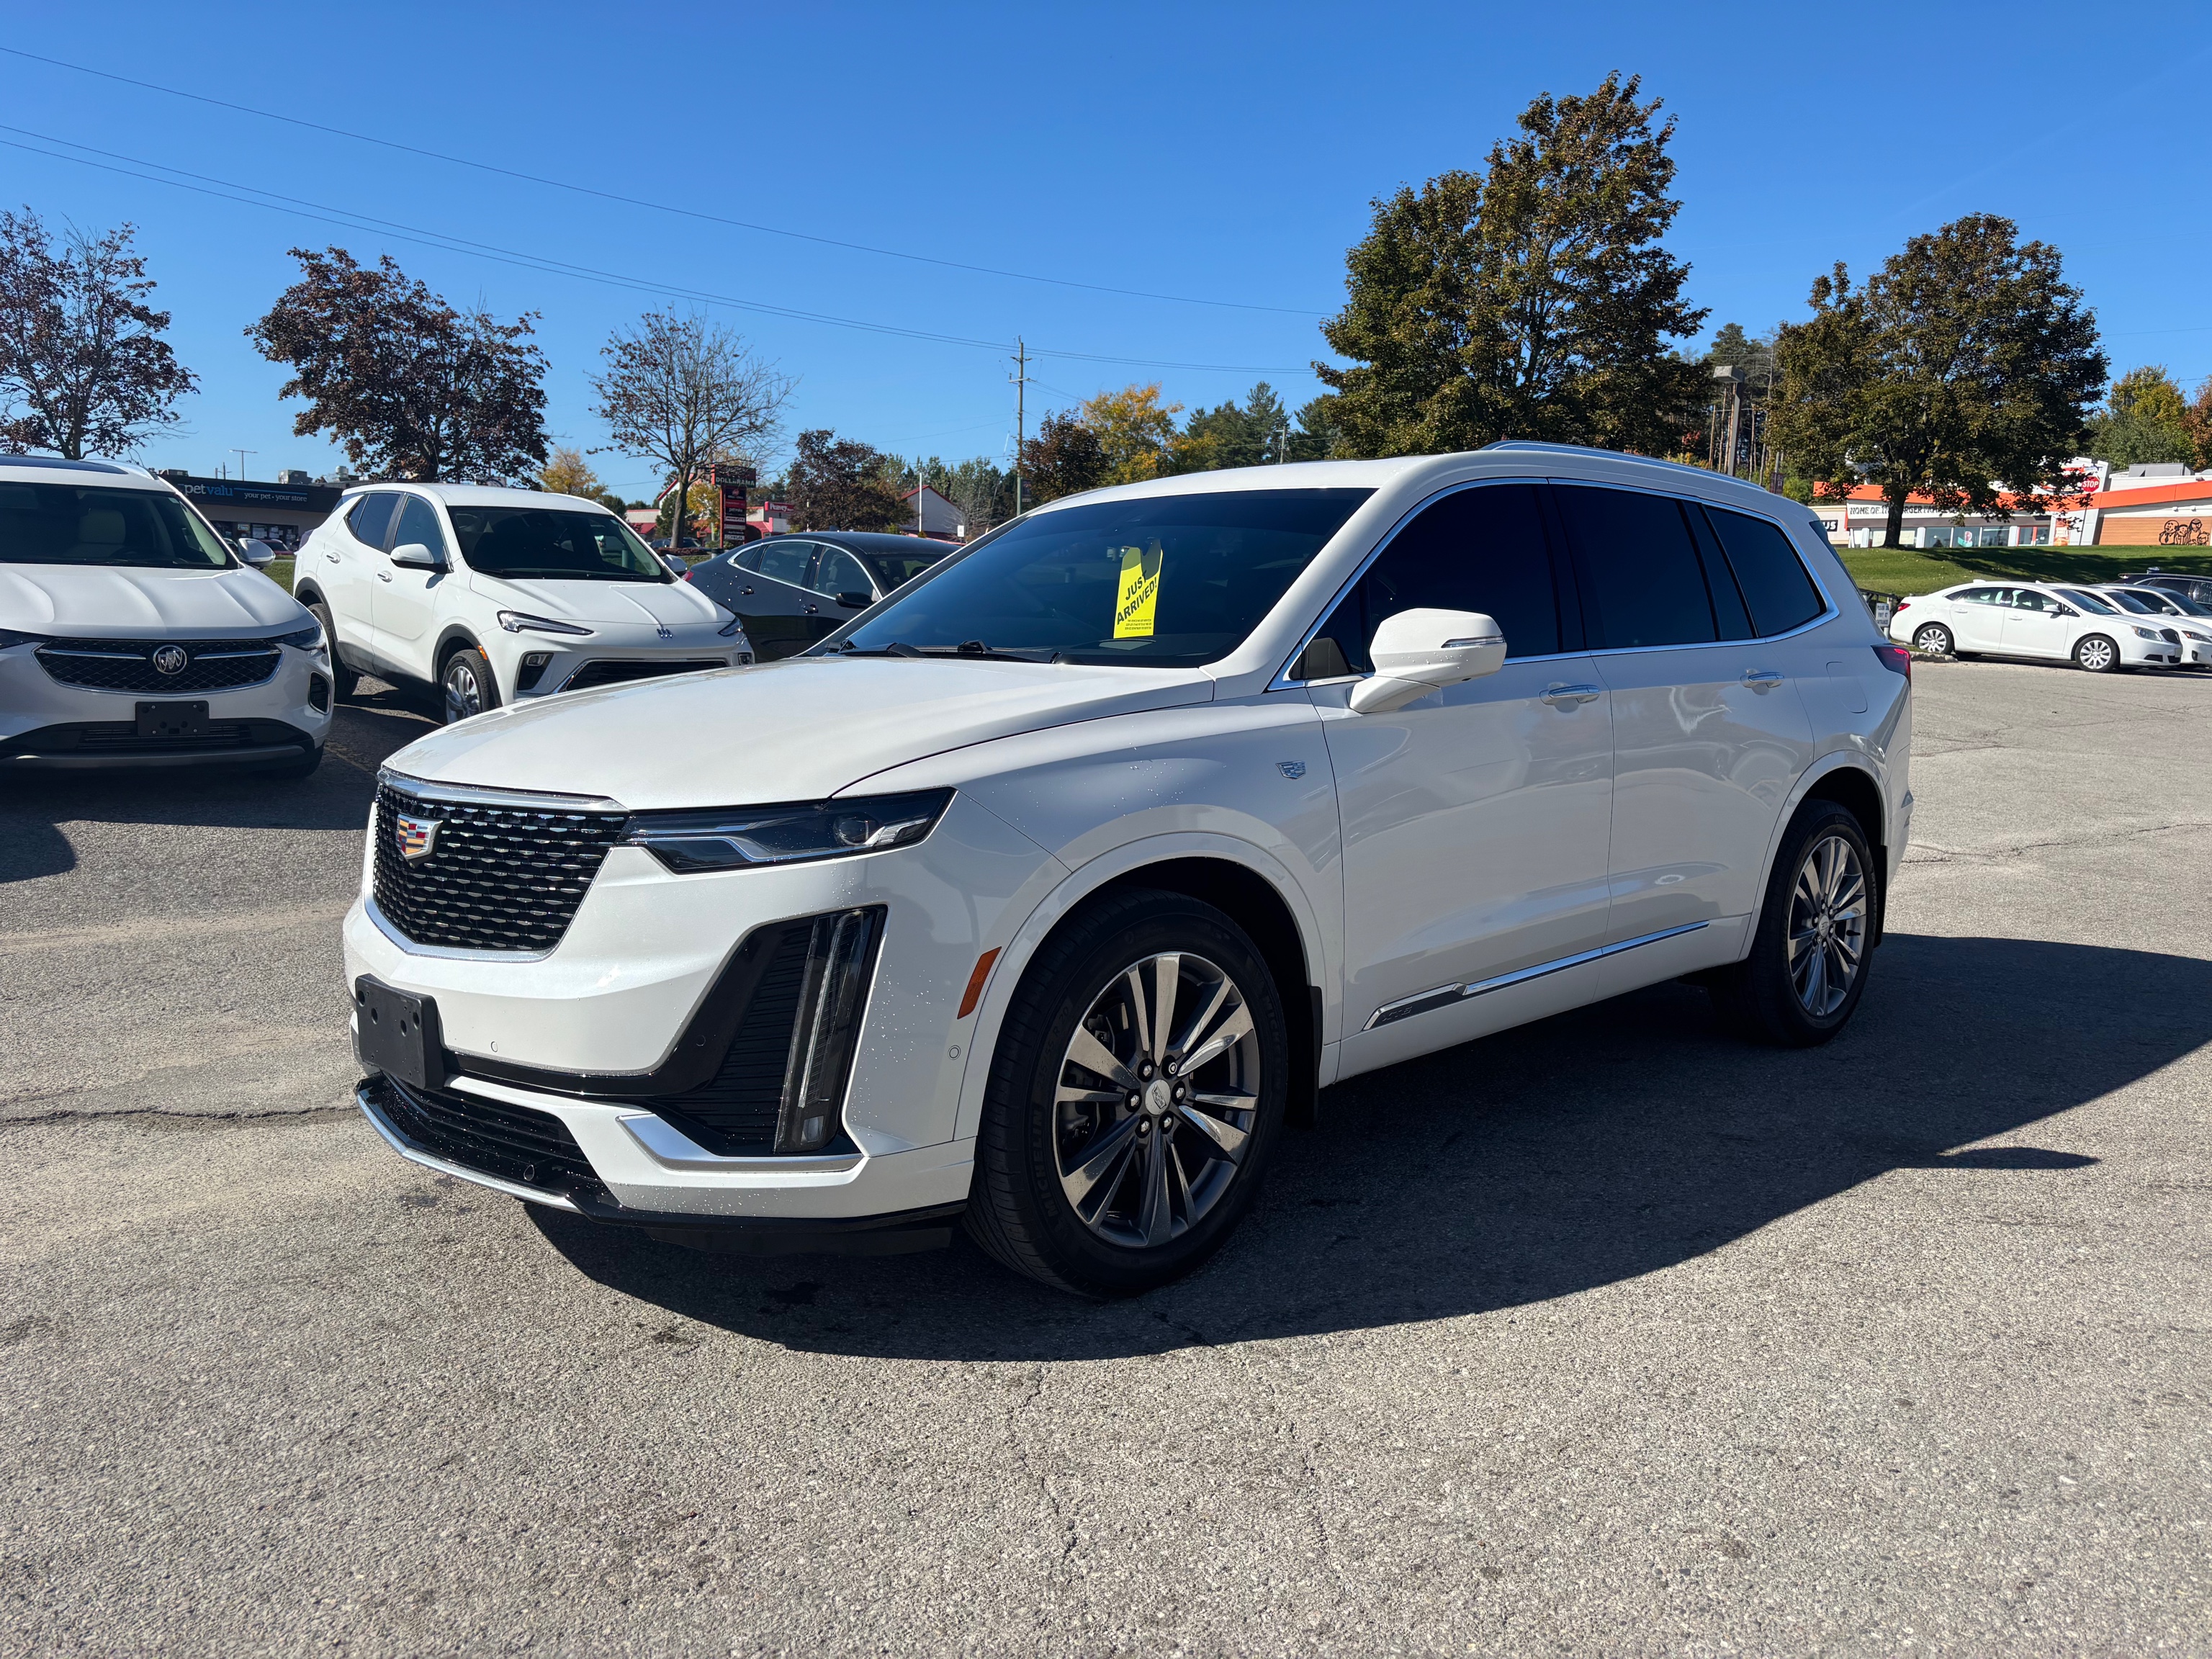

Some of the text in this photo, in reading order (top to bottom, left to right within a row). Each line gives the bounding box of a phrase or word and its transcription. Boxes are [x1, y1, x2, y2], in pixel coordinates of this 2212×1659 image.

[1118, 577, 1156, 625] ARRIVED!
[1125, 570, 1146, 601] JUST
[1031, 1110, 1058, 1218] MICHELIN
